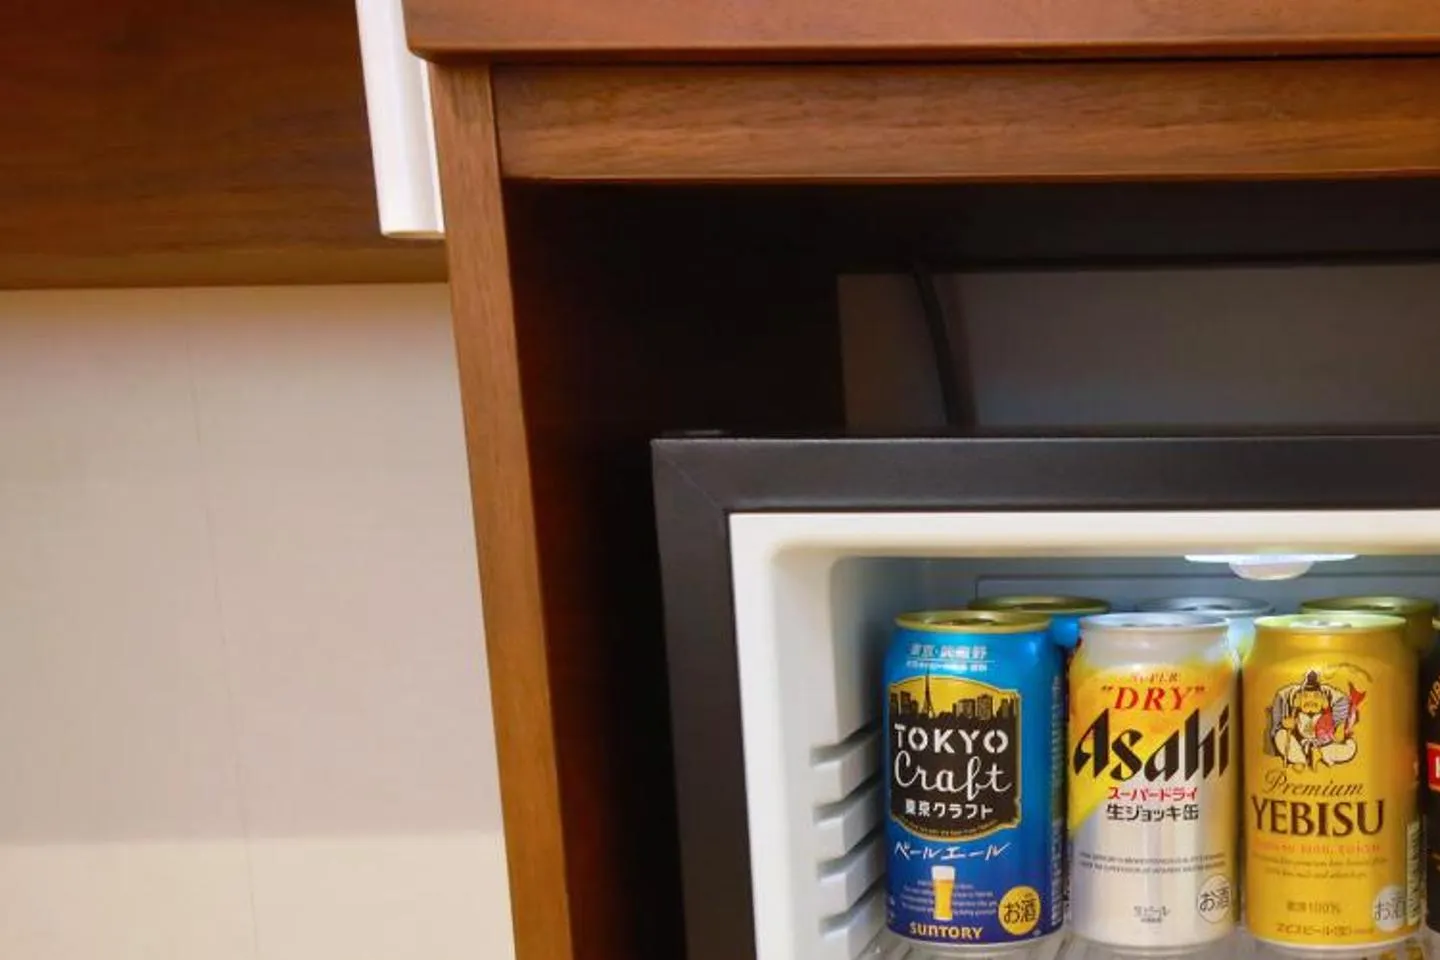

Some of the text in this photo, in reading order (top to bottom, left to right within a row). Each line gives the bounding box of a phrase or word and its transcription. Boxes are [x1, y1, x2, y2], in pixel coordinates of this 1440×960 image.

[894, 723, 1009, 754] TOKYO
[1073, 704, 1231, 782] Asahi
[894, 750, 1012, 801] Craft
[1262, 769, 1365, 797] Premium
[1107, 787, 1198, 801] スーパードライ
[905, 798, 994, 819] 東京クラフト
[1106, 803, 1200, 822] 生ジョッキ缶
[1251, 796, 1385, 837] YEBISU
[909, 921, 984, 940] SUNTORY
